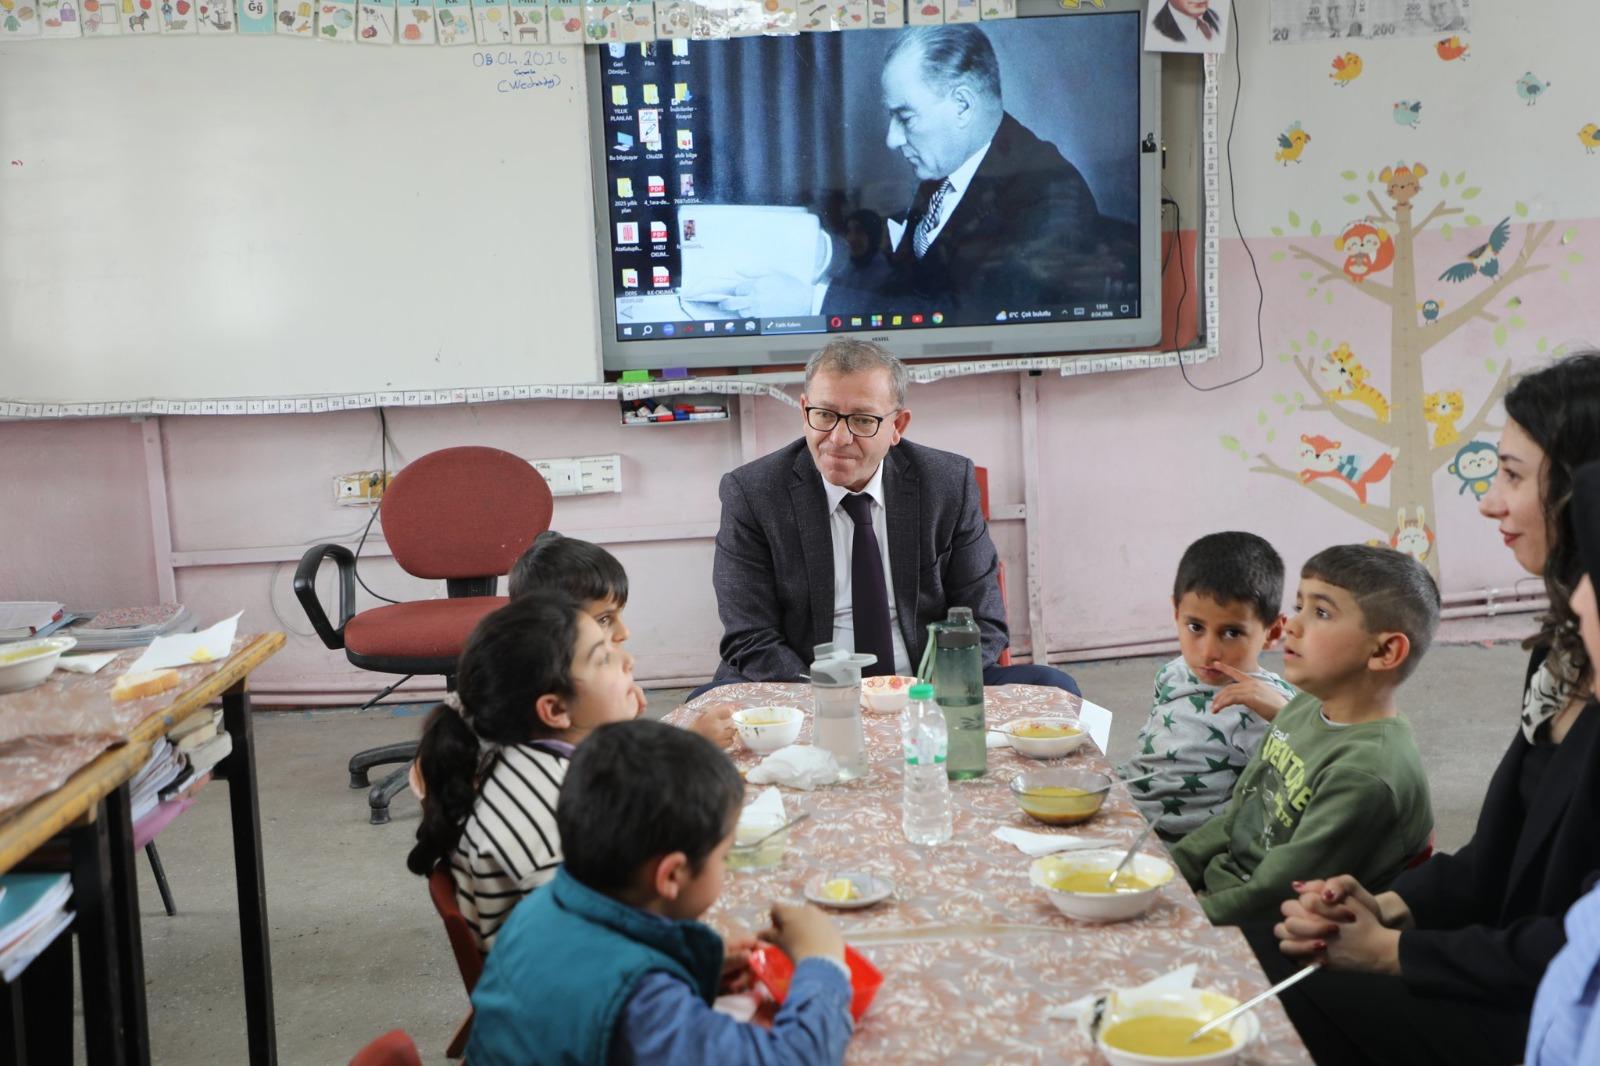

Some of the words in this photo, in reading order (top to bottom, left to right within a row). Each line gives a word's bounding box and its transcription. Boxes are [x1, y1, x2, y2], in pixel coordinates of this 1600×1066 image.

[248, 0, 263, 15] Ğğ
[1308, 6, 1320, 16] 20
[1272, 26, 1289, 42] 20
[1373, 23, 1396, 36] 200
